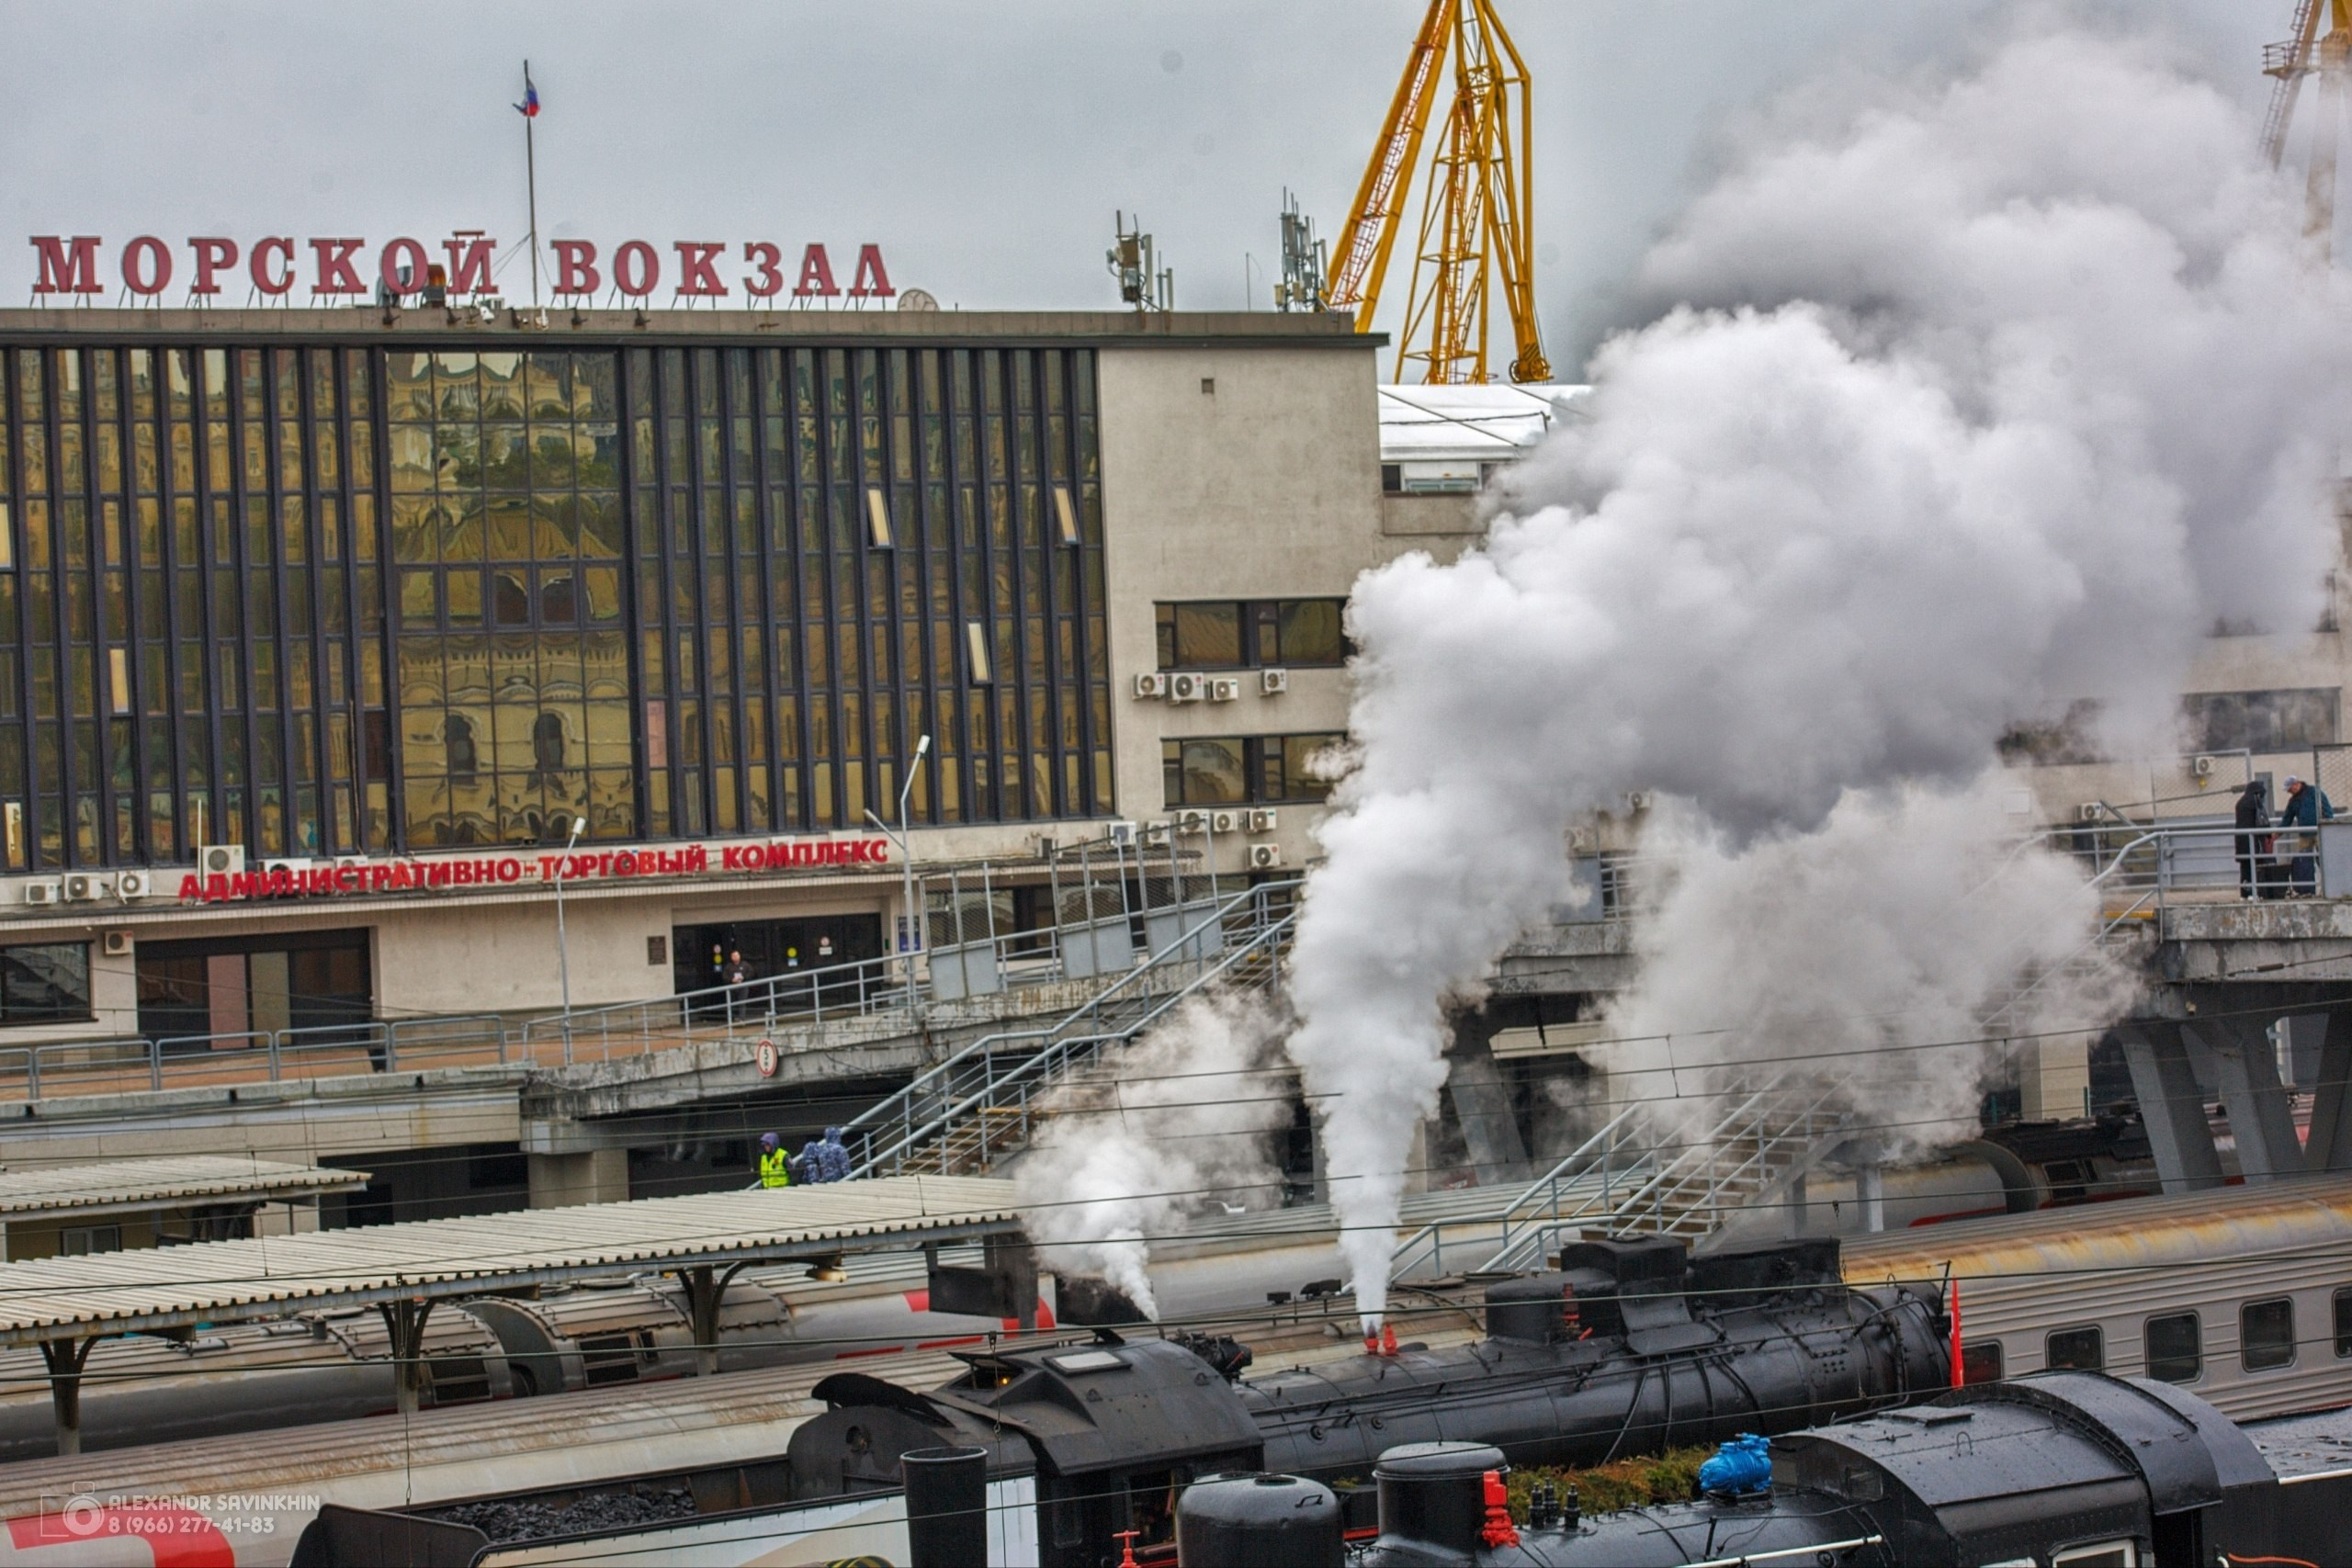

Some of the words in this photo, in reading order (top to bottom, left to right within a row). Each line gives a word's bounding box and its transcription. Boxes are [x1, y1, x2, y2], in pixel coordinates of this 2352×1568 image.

[30, 230, 499, 294] МОРСКОЙ
[551, 240, 897, 296] ВОКЗАЛ
[178, 844, 707, 903] АДМИНИСТРАТИВНО-ТОРГОВЫЙ
[722, 840, 888, 870] КОМПЛЕКС
